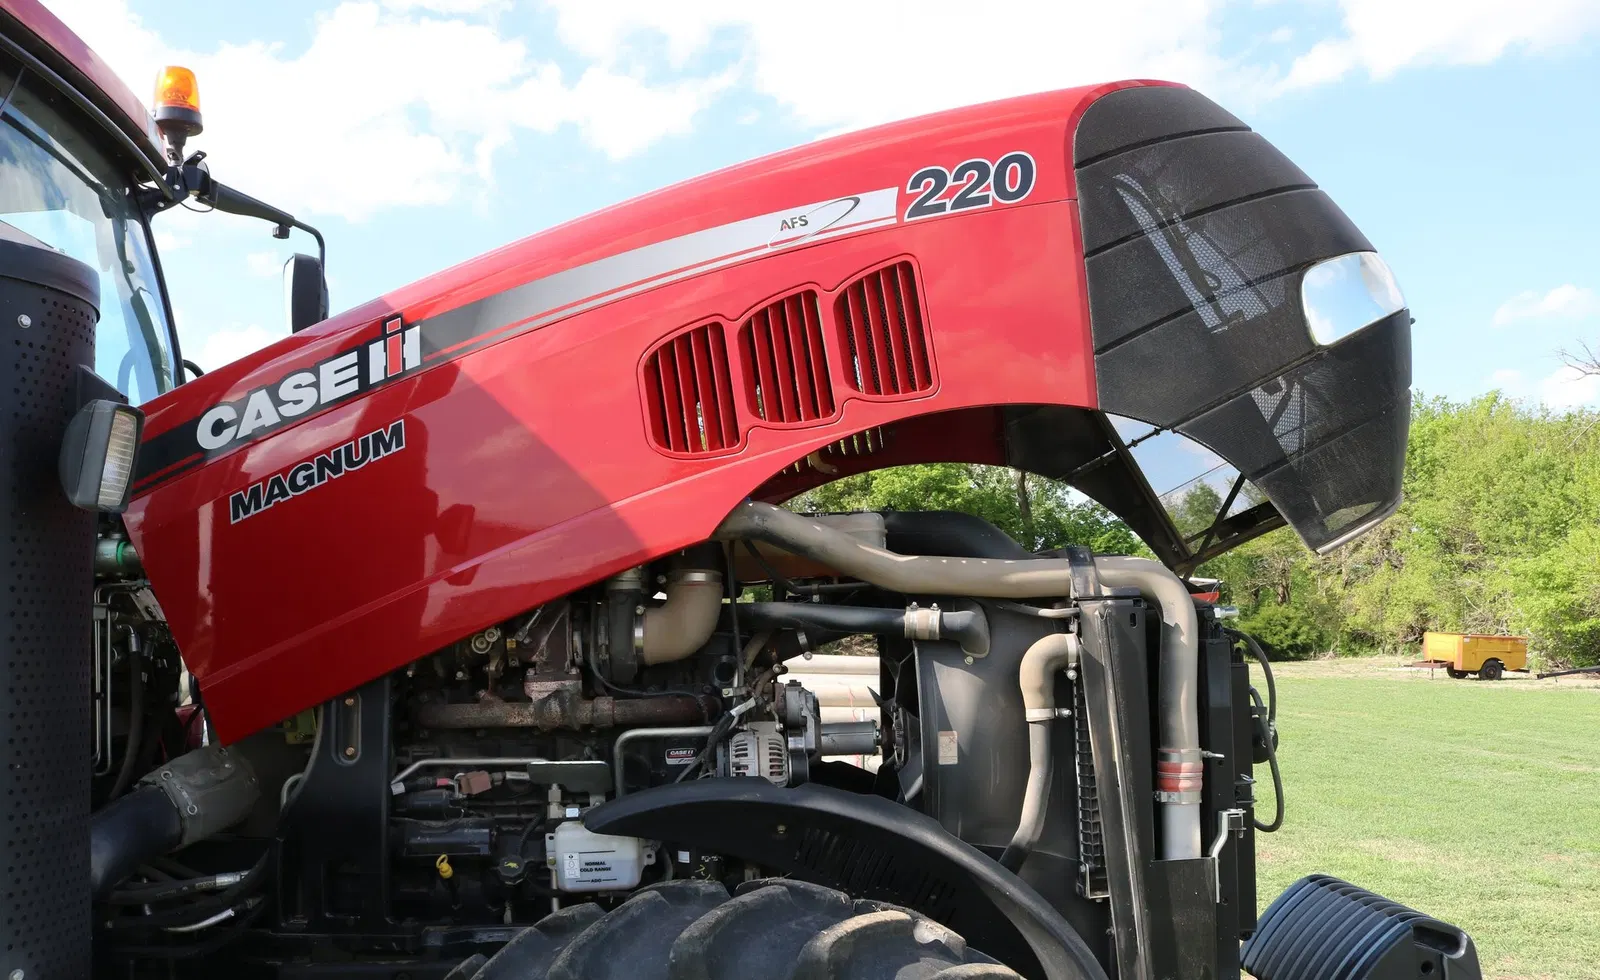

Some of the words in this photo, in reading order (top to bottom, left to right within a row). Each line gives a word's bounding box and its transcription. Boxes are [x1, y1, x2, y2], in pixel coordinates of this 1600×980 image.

[780, 215, 808, 231] AFS
[904, 151, 1036, 222] 220
[197, 351, 359, 450] CASE
[230, 419, 405, 524] MAGNUM
